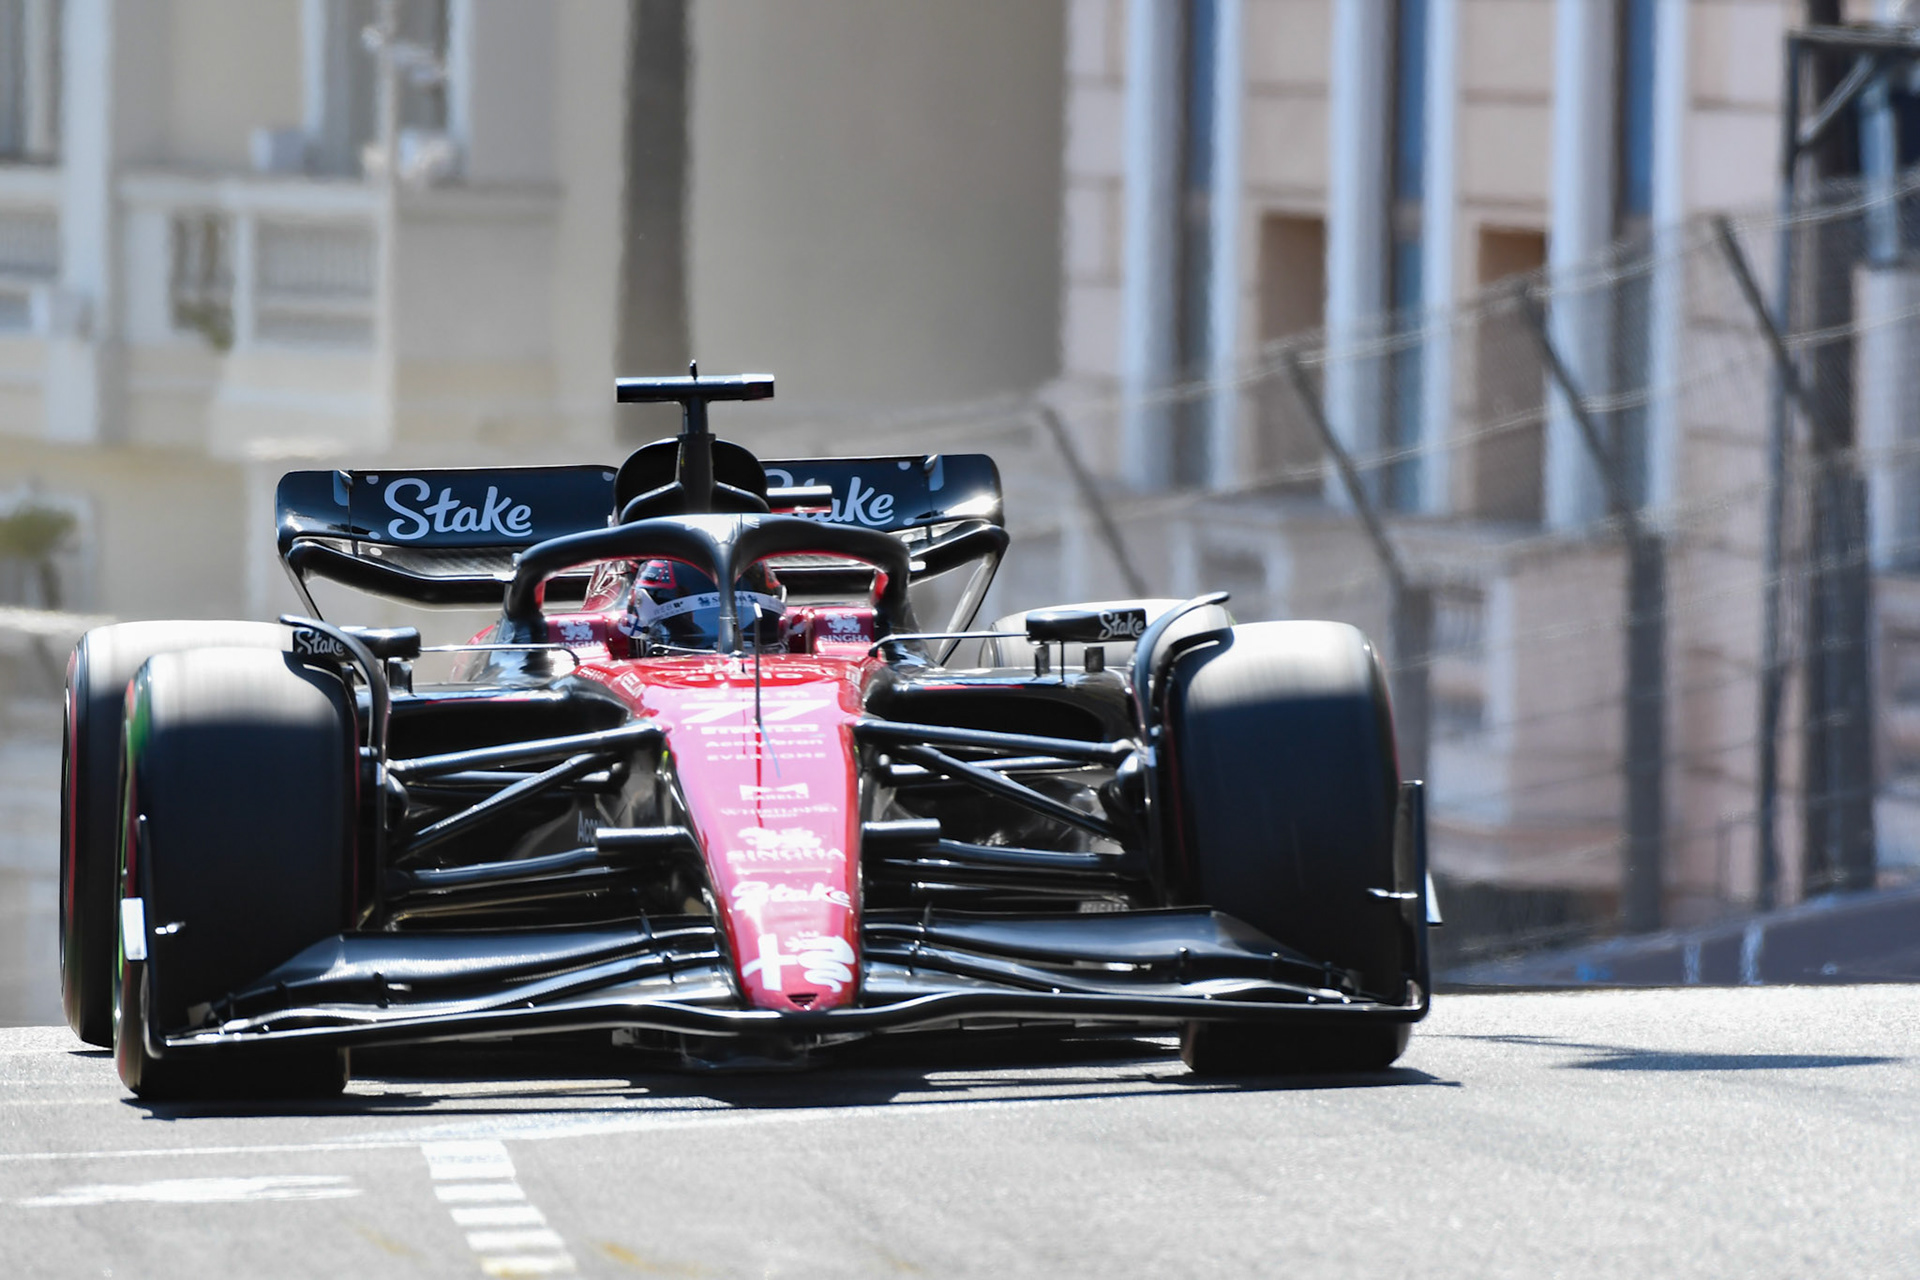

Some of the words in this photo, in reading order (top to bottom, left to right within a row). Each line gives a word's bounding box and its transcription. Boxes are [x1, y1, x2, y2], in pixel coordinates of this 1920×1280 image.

[384, 478, 533, 540] Stake
[819, 634, 871, 643] SINGHA
[1098, 610, 1144, 640] Stake
[295, 627, 345, 657] Stake
[552, 640, 603, 651] INGHA
[680, 700, 832, 724] 77
